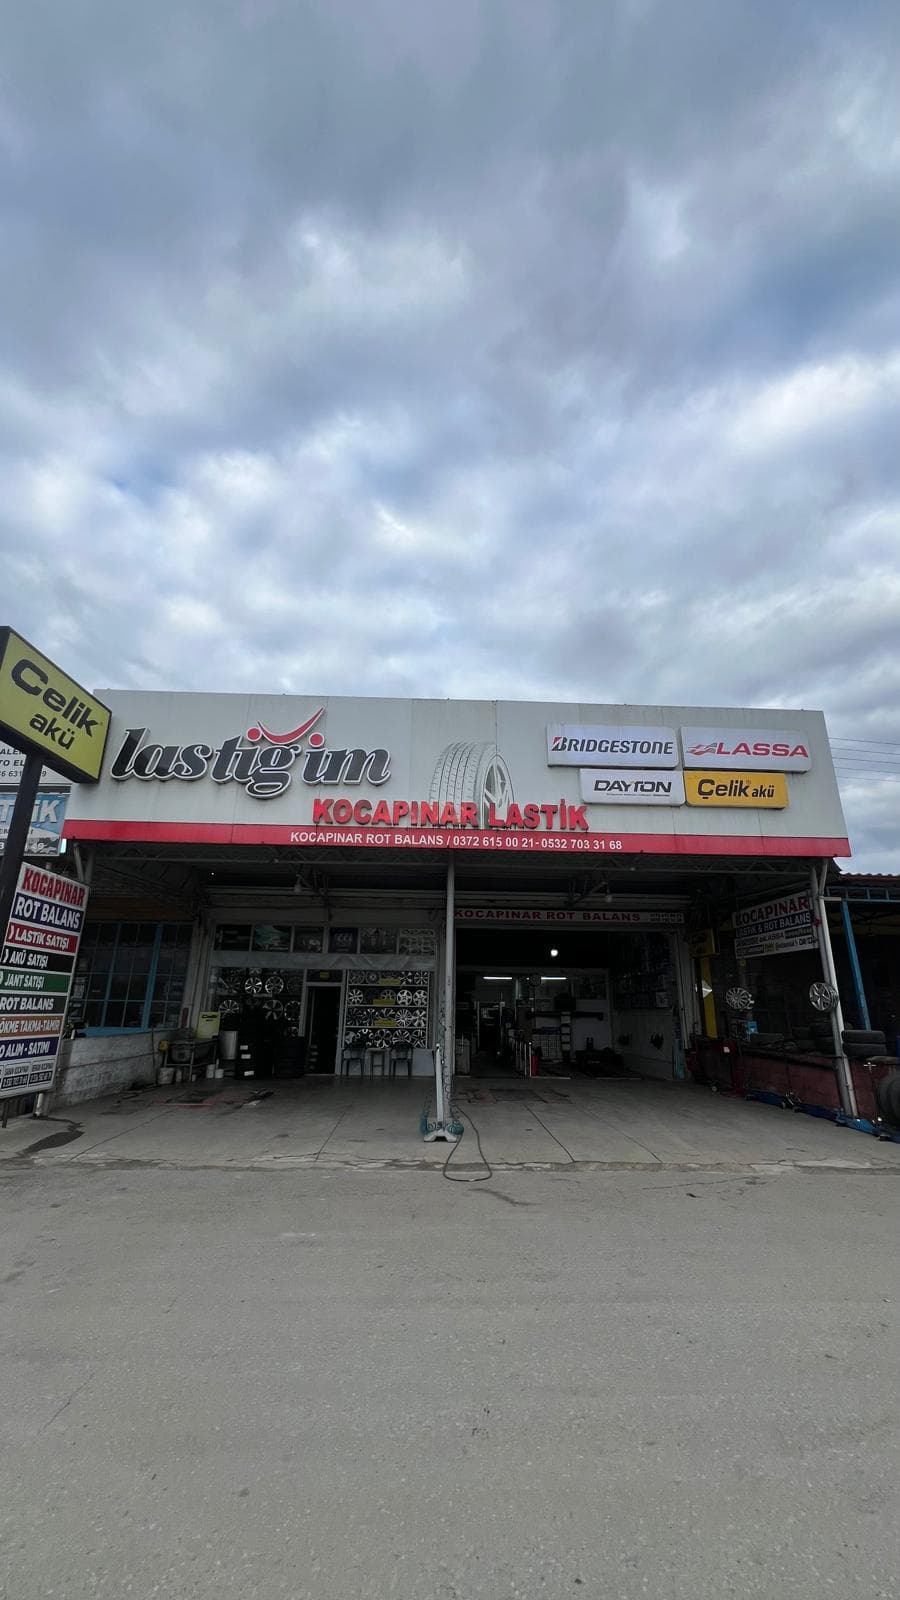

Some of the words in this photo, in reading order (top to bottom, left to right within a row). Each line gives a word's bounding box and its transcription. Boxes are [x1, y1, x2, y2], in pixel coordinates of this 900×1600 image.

[29, 713, 75, 750] akü
[551, 736, 674, 755] BRIDGESTONE
[716, 742, 809, 758] LASSA
[594, 779, 672, 793] DAYTON
[697, 779, 750, 799] Çelik
[751, 785, 775, 798] akü
[312, 799, 479, 828] KOCAPINAR
[487, 799, 589, 830] LASTİK
[290, 831, 363, 844] KOCAPINAR
[366, 833, 391, 844] ROT
[394, 834, 443, 846] BALANS
[453, 836, 480, 847] 0372
[482, 837, 502, 847] 615
[505, 838, 518, 847] 00
[571, 839, 590, 849] 703
[593, 840, 605, 849] 31
[609, 840, 622, 850] 68
[22, 868, 86, 907] KOCAPINAR
[15, 897, 41, 919] ROT
[40, 903, 81, 929] BALANS
[454, 909, 541, 921] KOCAPINAR
[546, 911, 576, 921] ROT
[582, 911, 641, 922] BALANS
[734, 896, 810, 926] KOCAPINAR
[15, 927, 47, 945] LASTİK
[45, 934, 70, 951] SATIŞI
[9, 949, 27, 964] AKÜ
[27, 953, 49, 969] SATIŞI
[5, 973, 24, 987] JANT
[24, 974, 45, 989] SATIŞI
[0, 997, 20, 1010] ROT
[20, 997, 54, 1010] BALANS
